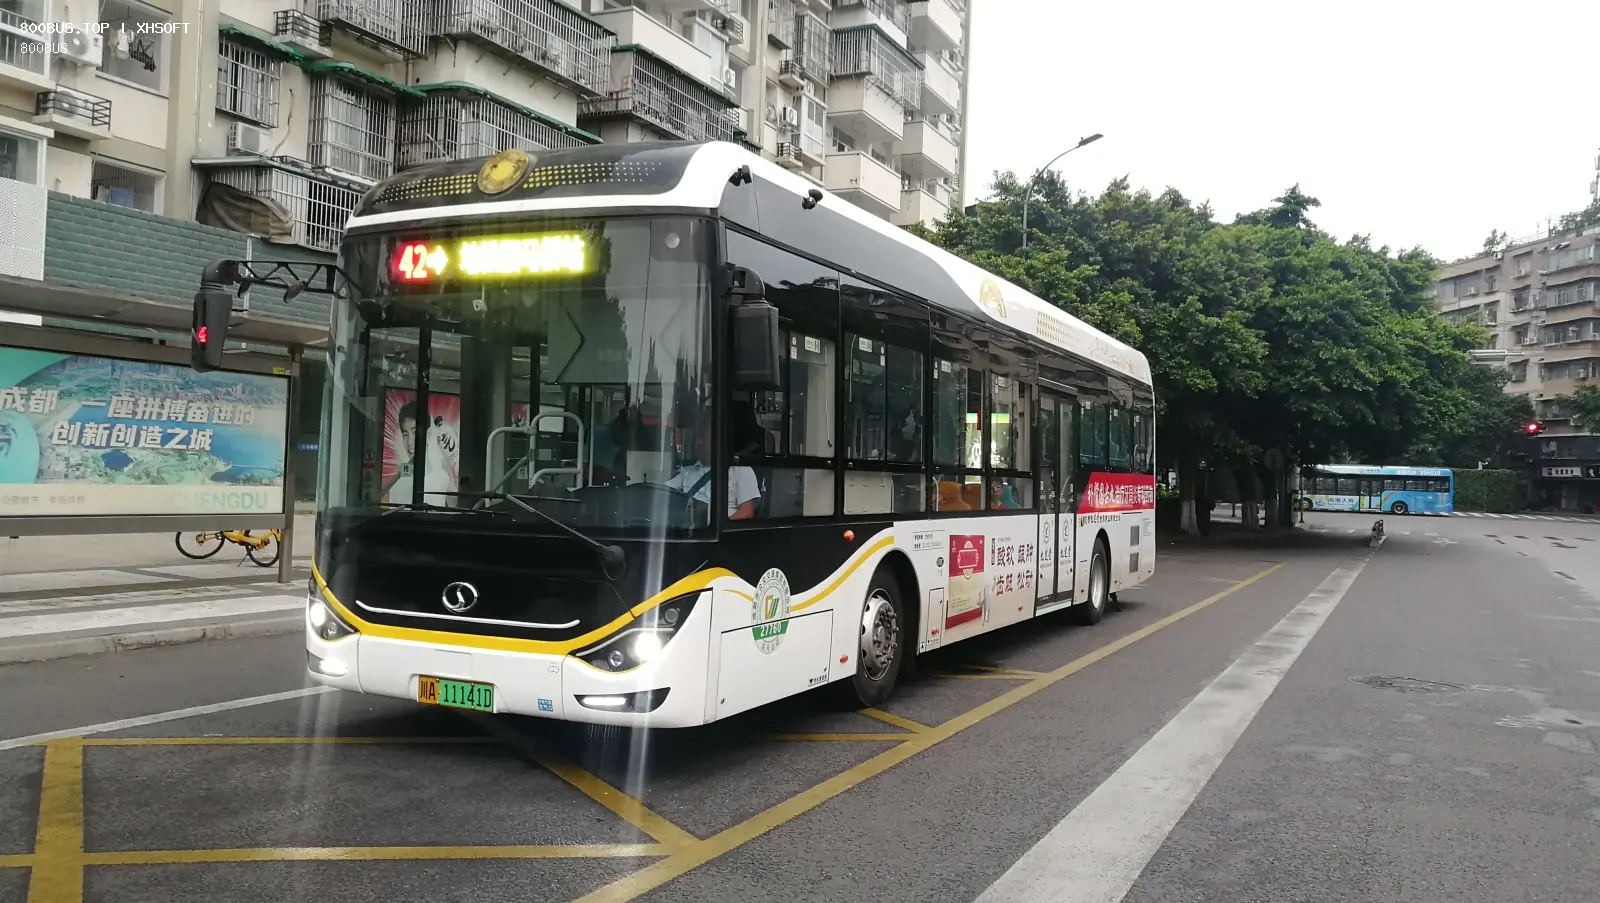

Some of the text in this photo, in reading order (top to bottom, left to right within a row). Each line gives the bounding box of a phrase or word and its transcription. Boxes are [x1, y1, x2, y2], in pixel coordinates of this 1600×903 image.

[398, 244, 428, 280] 42
[0, 386, 58, 414] 成都
[52, 420, 215, 452] 创新创造之城
[760, 622, 782, 637] 27760
